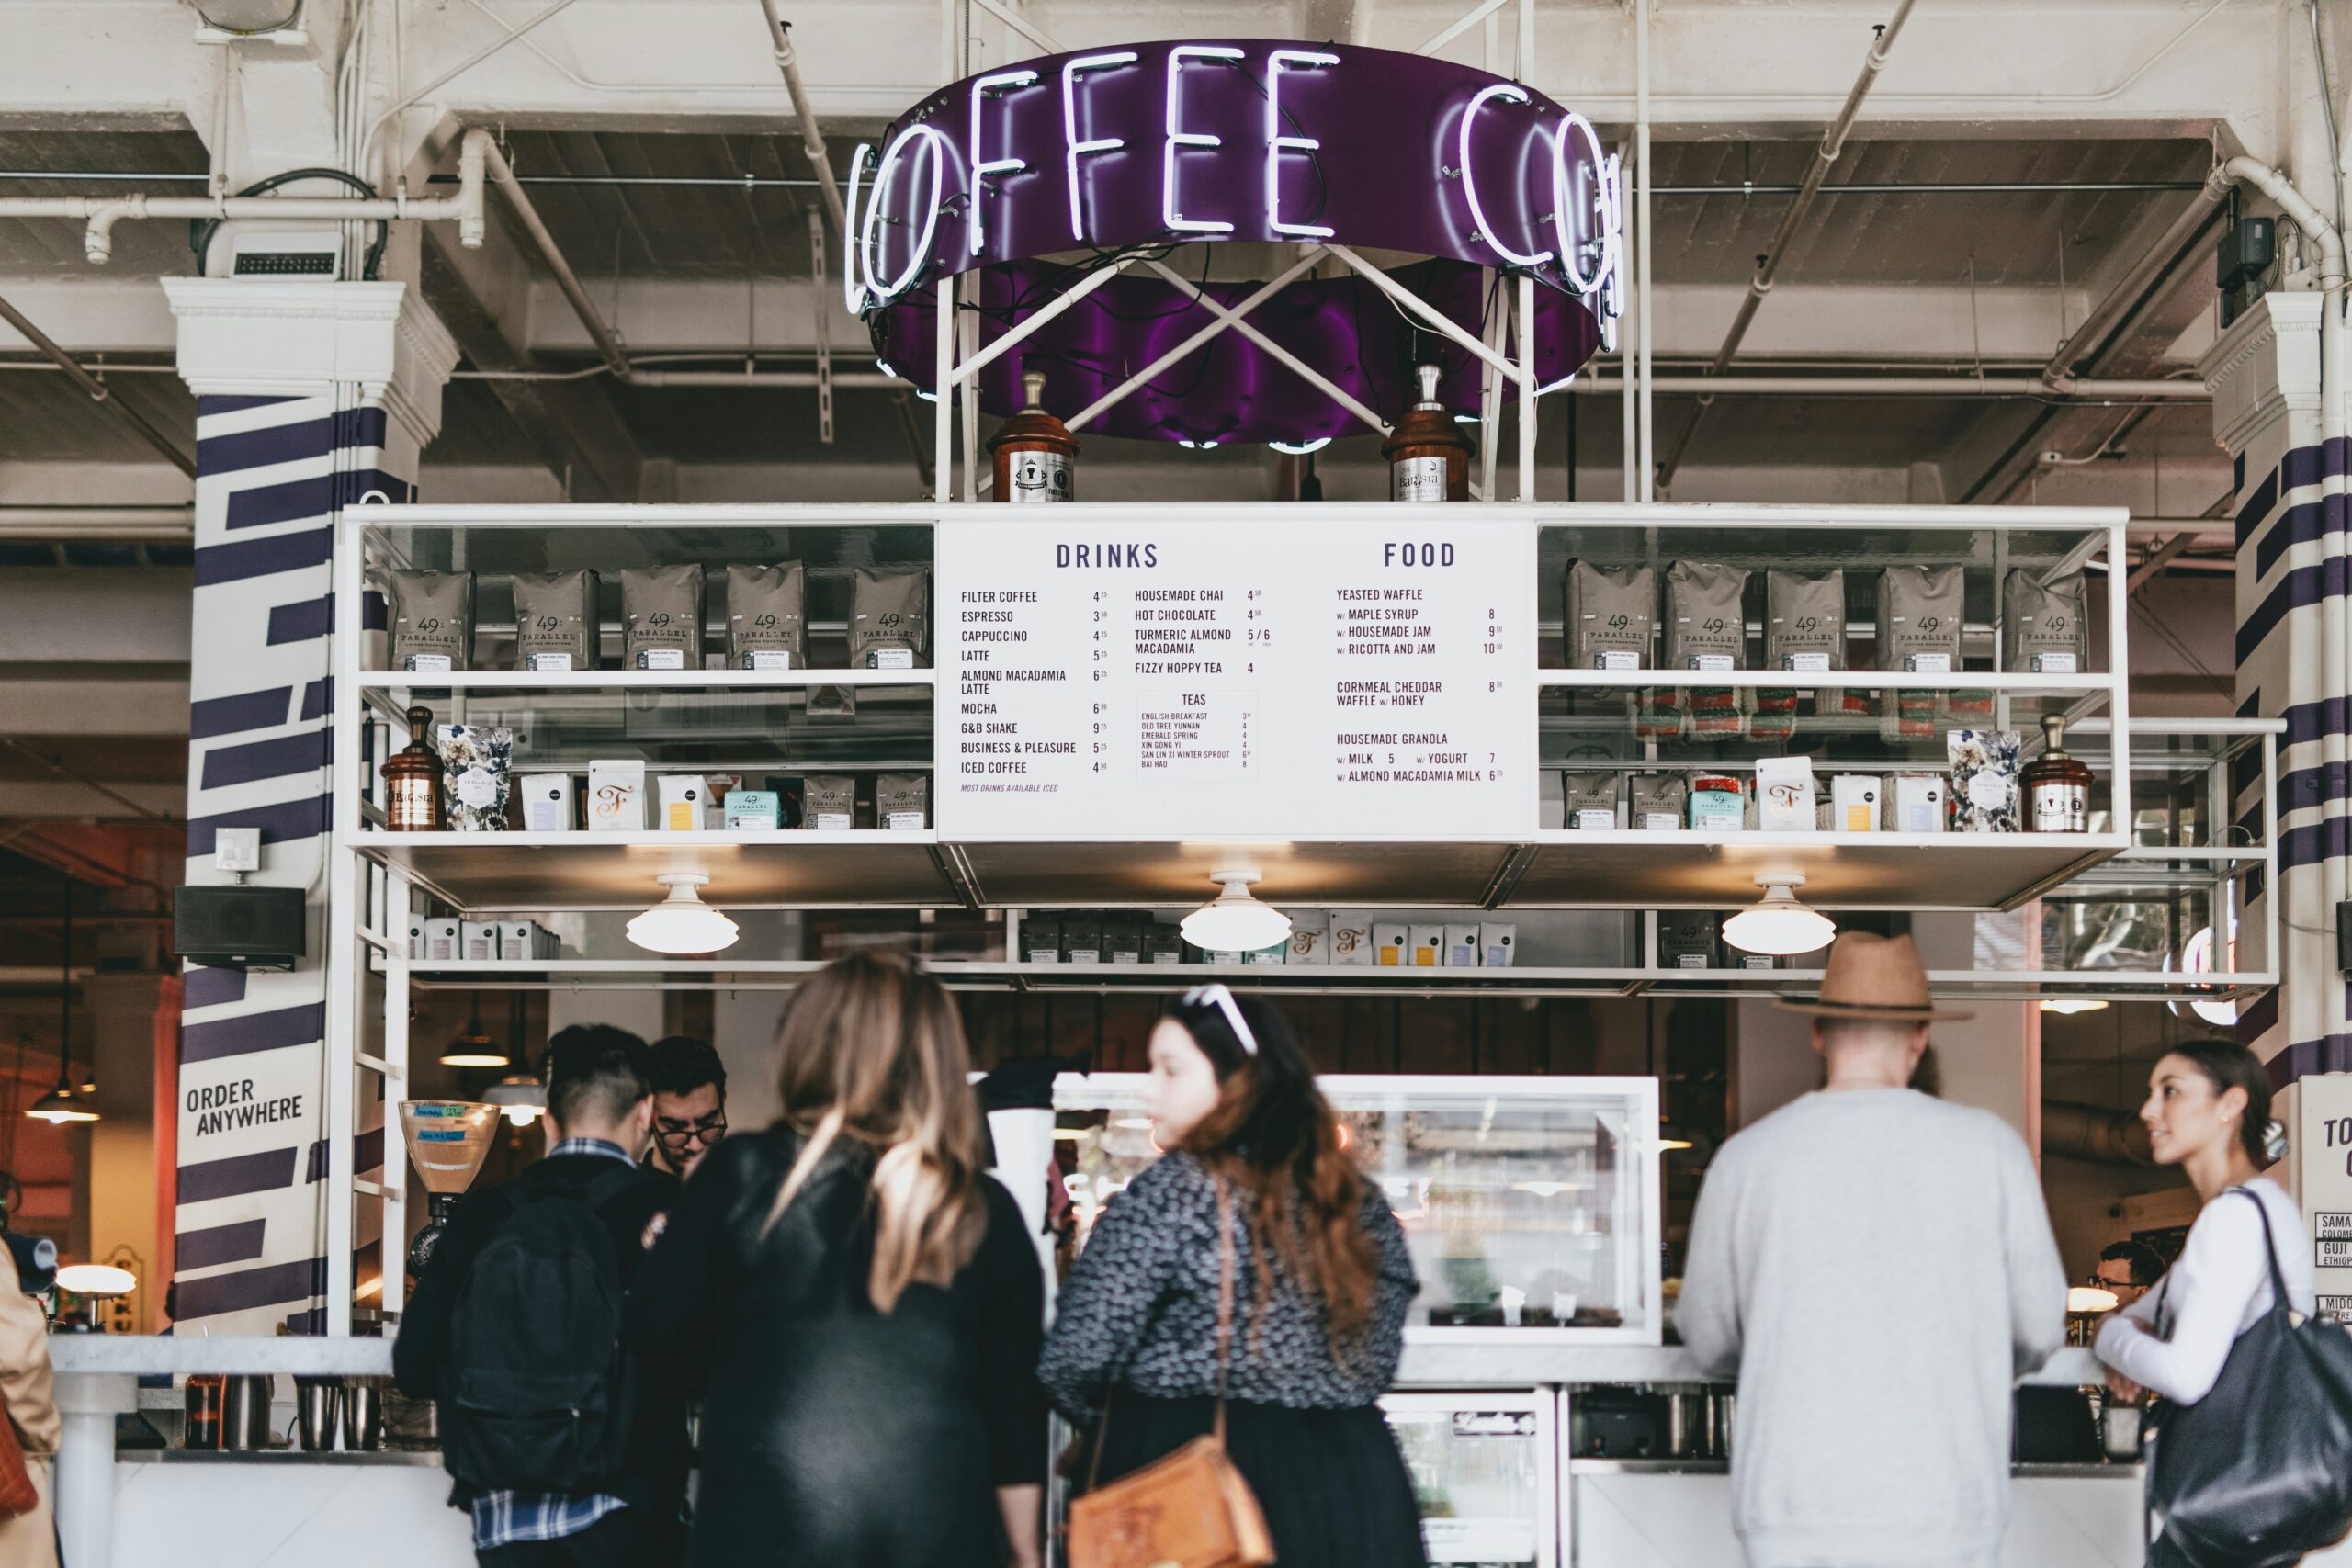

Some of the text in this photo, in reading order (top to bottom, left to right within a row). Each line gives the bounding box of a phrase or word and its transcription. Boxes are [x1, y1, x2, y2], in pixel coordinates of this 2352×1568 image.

[1057, 544, 1157, 568] DRINKS
[1385, 543, 1454, 567] FOOD
[962, 592, 995, 603] FILTER
[1000, 592, 1037, 603] COFFEE
[1135, 590, 1196, 601] HOUSEMADE
[1200, 590, 1223, 601] CHAI
[1337, 589, 1423, 601] YEASTED WAFFLE
[962, 611, 1013, 623] ESPRESSO
[1135, 610, 1154, 621] HOT
[1158, 610, 1216, 621] CHOCOLATE
[1349, 609, 1382, 620] MAPLE
[1385, 609, 1419, 620] SYRUP
[1489, 608, 1495, 619] 8
[522, 633, 576, 641] PARALLEL
[632, 629, 687, 637] PARALLEL
[739, 631, 793, 639] PARALLEL
[862, 630, 916, 638] PARALLEL
[961, 630, 1027, 643] CAPPUCCINO
[1135, 629, 1188, 641] TURMERIC
[1190, 628, 1231, 641] ALMOND
[1248, 629, 1254, 641] 5
[1263, 629, 1271, 641] 6
[1349, 626, 1409, 637] HOUSEMADE
[1413, 626, 1431, 637] JAM
[1589, 631, 1644, 639] PARALLEL
[1778, 633, 1833, 641] PARALLEL
[2026, 633, 2081, 641] PARALLEL
[401, 635, 457, 644] PARALLEL
[1684, 635, 1739, 643] PARALLEL
[1135, 643, 1195, 654] MACADAMIA
[1349, 643, 1390, 654] RICOTTA
[1394, 643, 1414, 654] AND
[1417, 643, 1435, 654] JAM
[962, 650, 990, 661] LATTE
[1136, 662, 1254, 673] FIZZY HOPPY TEA 4
[961, 670, 1002, 682] ALMOND
[1006, 670, 1066, 681] MACADAMIA
[961, 683, 990, 694] LATTE
[1337, 682, 1391, 693] CORNMEAL
[1395, 682, 1442, 693] CHEDDAR
[1182, 694, 1205, 705] TEAS
[1337, 695, 1376, 706] WAFFLE
[1392, 695, 1425, 706] HONEY
[961, 703, 997, 715] MOCHA
[961, 722, 982, 734] G&B
[986, 723, 1018, 734] SHAKE
[1141, 722, 1154, 730] OLD
[1155, 722, 1172, 730] TREE
[1173, 722, 1201, 730] YUNNAN
[1337, 733, 1448, 745] HOUSEMADE GRANOLA
[961, 742, 1011, 753] BUSINESS
[1014, 742, 1022, 753] &
[1025, 742, 1077, 753] PLEASURE
[1141, 750, 1156, 759] SAN
[1156, 750, 1168, 759] LIN
[1168, 750, 1176, 759] XI
[1176, 750, 1203, 759] WINTER
[1204, 750, 1230, 759] SPROUT
[1349, 752, 1373, 764] MILK
[1389, 753, 1395, 764] 5
[1428, 753, 1468, 764] YOGURT
[1489, 752, 1495, 763] 7
[961, 761, 984, 773] ICED
[989, 761, 1027, 773] COFFEE
[1349, 771, 1389, 782] ALMOND
[1394, 770, 1453, 782] MACADAMIA
[1456, 770, 1481, 781] MILK
[960, 784, 1058, 793] MOST DRINKS AVAILABLE ICED
[187, 1079, 254, 1112] ORDER
[196, 1095, 302, 1136] ANYWHERE
[2322, 1215, 2351, 1228] SAMA
[2324, 1242, 2347, 1255] GUJI
